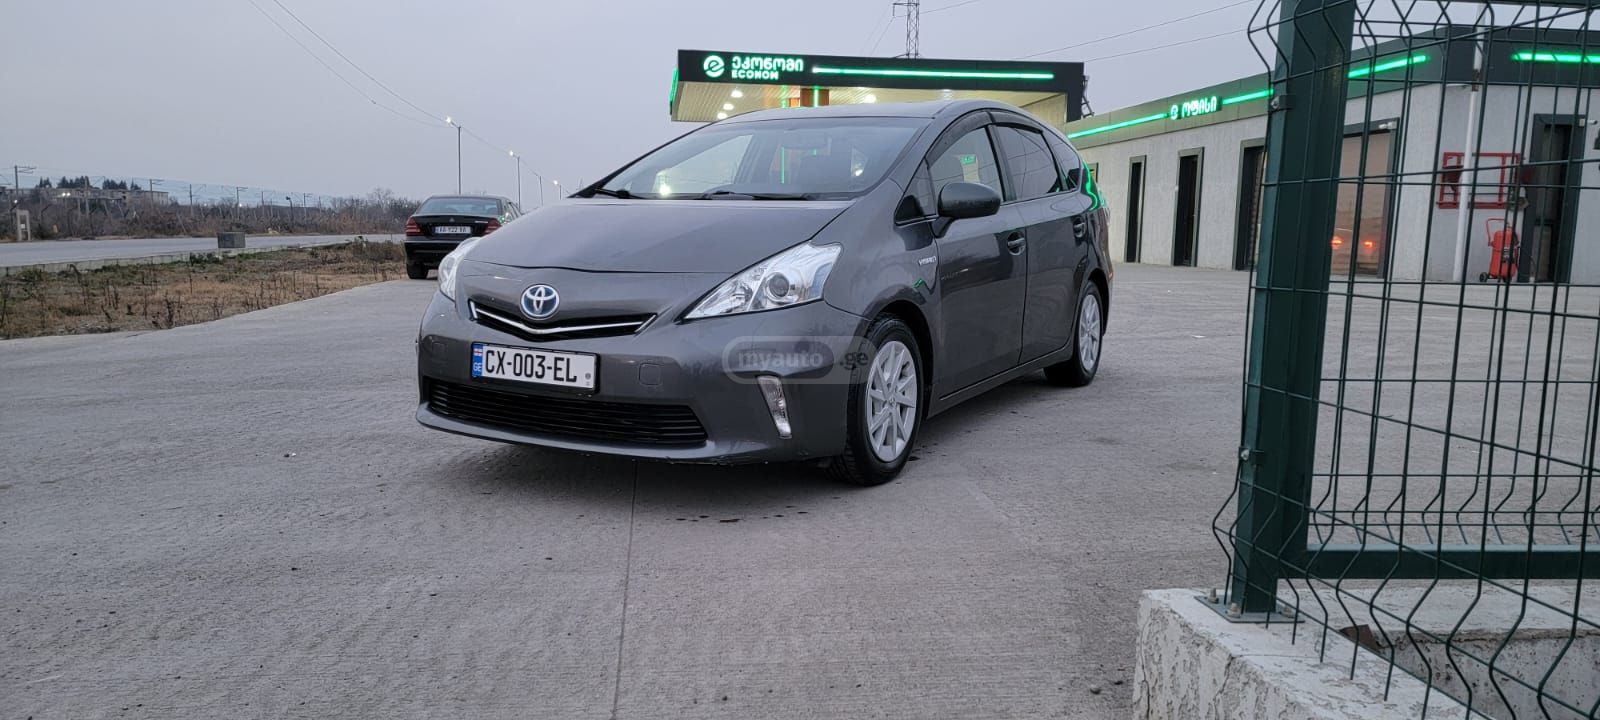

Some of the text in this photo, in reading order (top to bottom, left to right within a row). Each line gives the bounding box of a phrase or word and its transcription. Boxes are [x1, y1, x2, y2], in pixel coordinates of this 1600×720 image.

[731, 55, 804, 72] ეკონომი
[731, 70, 779, 80] ECONOM
[485, 350, 578, 383] CX-003-EL
